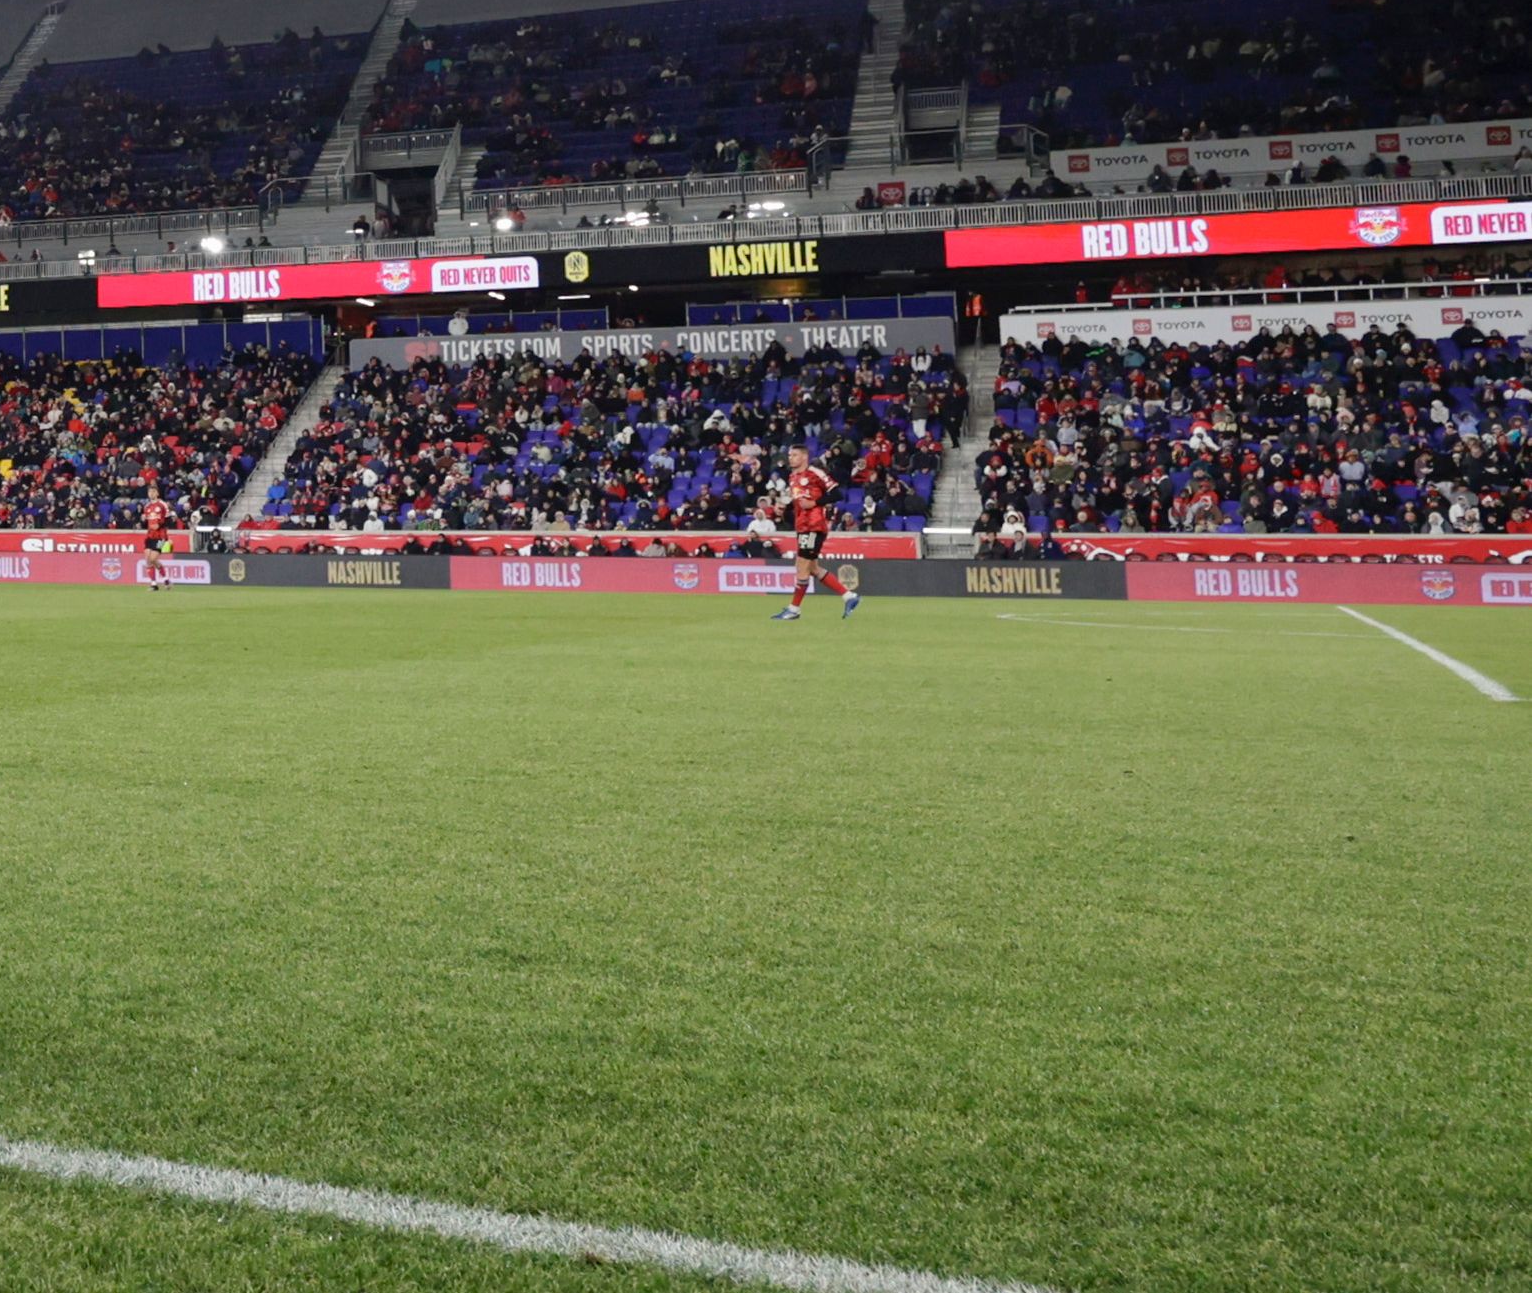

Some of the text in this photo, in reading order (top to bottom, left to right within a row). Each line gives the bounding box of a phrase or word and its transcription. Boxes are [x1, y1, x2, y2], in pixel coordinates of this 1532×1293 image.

[1298, 141, 1356, 154] TOYOTA
[1406, 134, 1466, 146] TOYOTA
[1095, 155, 1149, 167] TOYOTA
[1195, 148, 1250, 160] TOYOTA
[1444, 212, 1527, 237] RED NEVER
[1082, 219, 1209, 259] RED BULLS
[709, 240, 819, 277] NASHVILLE
[193, 269, 281, 301] RED BULLS
[440, 265, 530, 286] RED NEVER QUITS
[1156, 321, 1206, 330] TOYOTA
[1257, 317, 1308, 327] TOYOTA
[1360, 313, 1414, 324] TOYOTA
[1468, 310, 1523, 320] TOYOTA
[1060, 324, 1107, 333] TOYOTA
[440, 338, 515, 361] TICKETS
[521, 336, 561, 359] COM
[581, 324, 887, 357] SPORTS CONCERTS THEATER
[56, 543, 135, 553] STADIUM
[327, 561, 401, 585] NASHVILLE
[501, 562, 581, 587] RED BULLS
[966, 566, 1062, 595] NASHVILLE
[1194, 569, 1299, 597] RED BULLS
